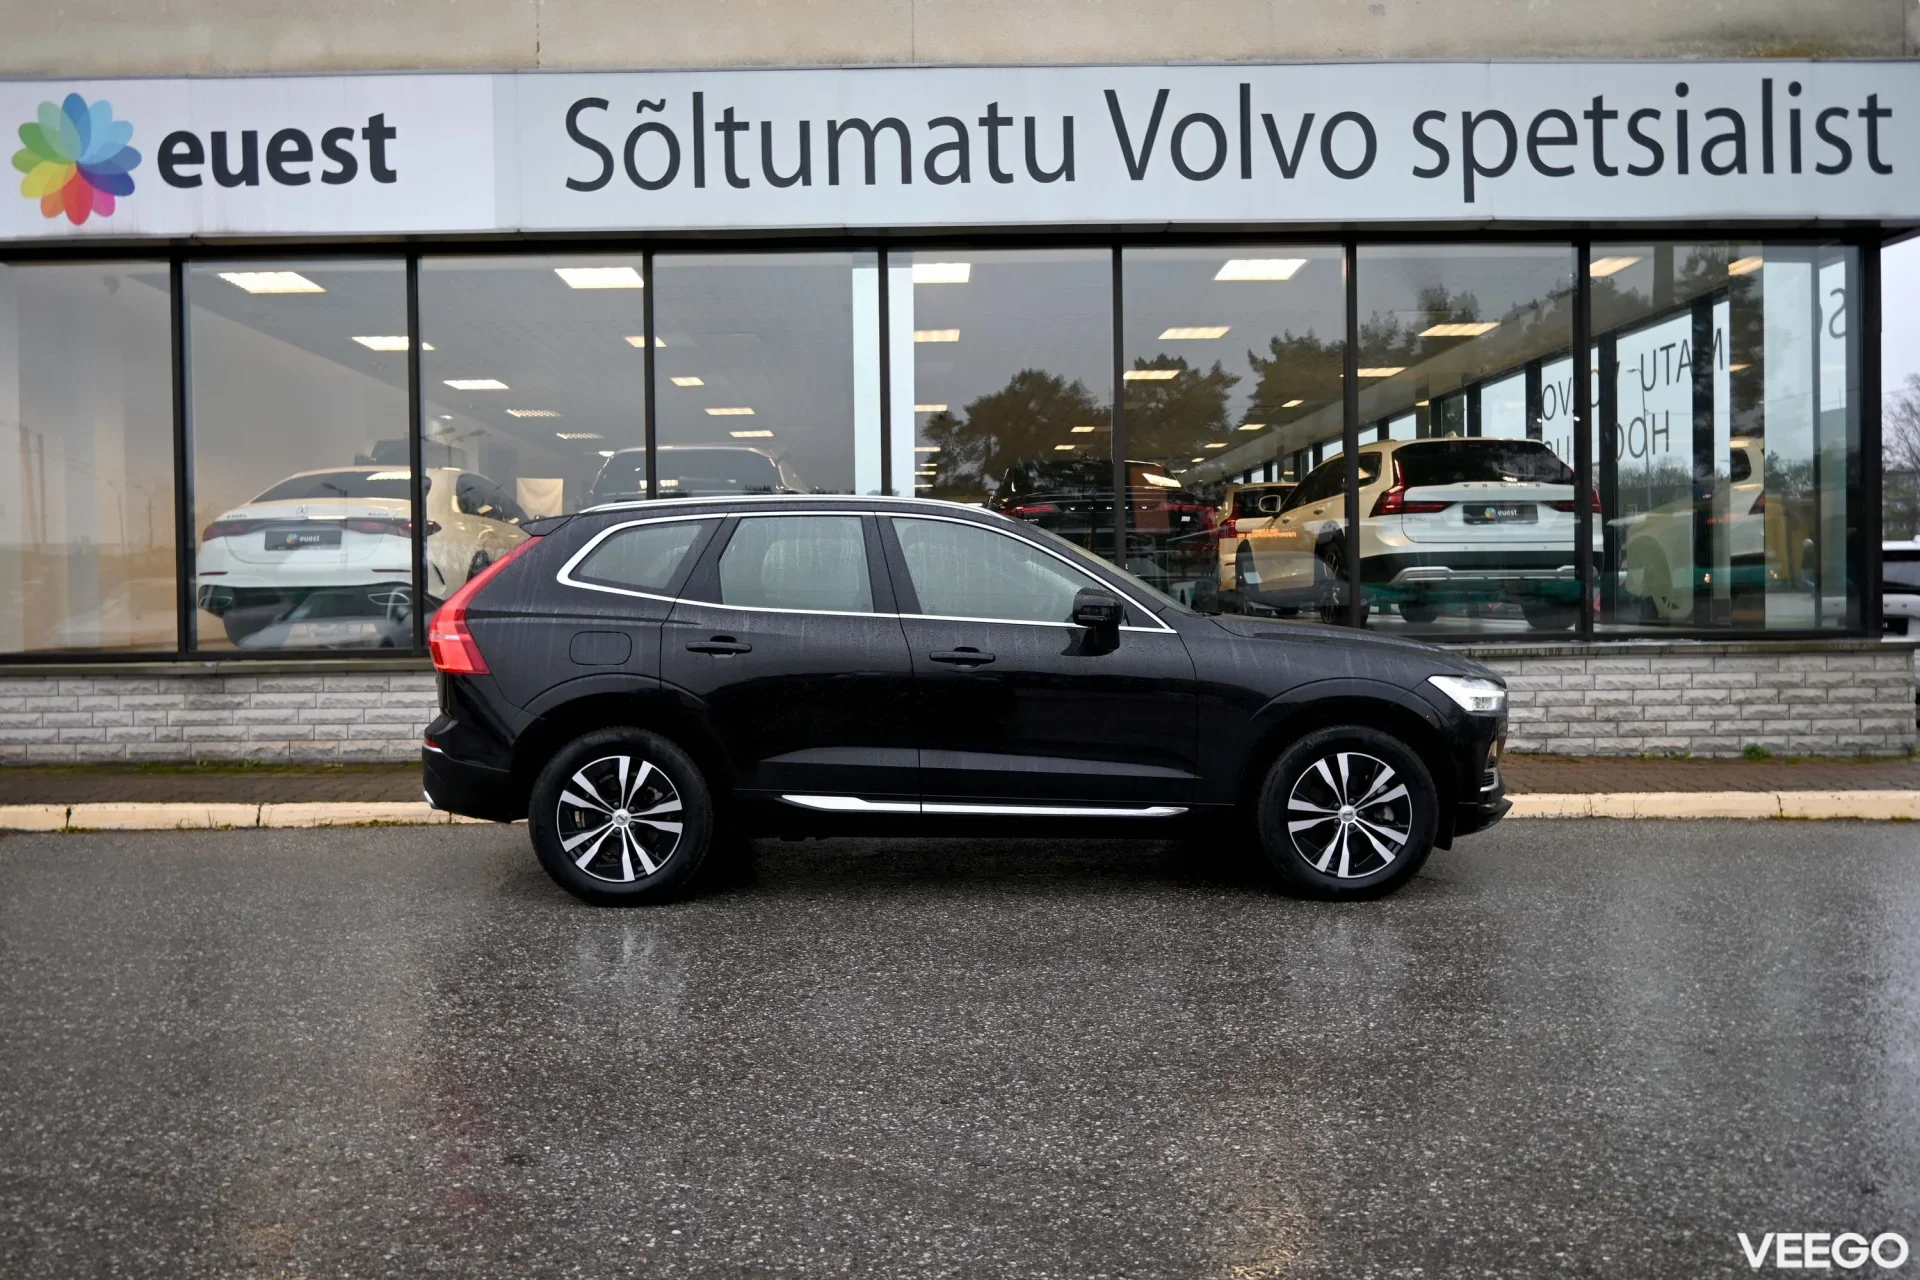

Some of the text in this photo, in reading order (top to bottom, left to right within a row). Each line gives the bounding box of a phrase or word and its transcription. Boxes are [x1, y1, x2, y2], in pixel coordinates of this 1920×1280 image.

[157, 112, 397, 188] euest
[564, 78, 1893, 203] Sõltumatu Volvo spetsialist
[1497, 509, 1518, 517] euest
[299, 534, 320, 542] euest
